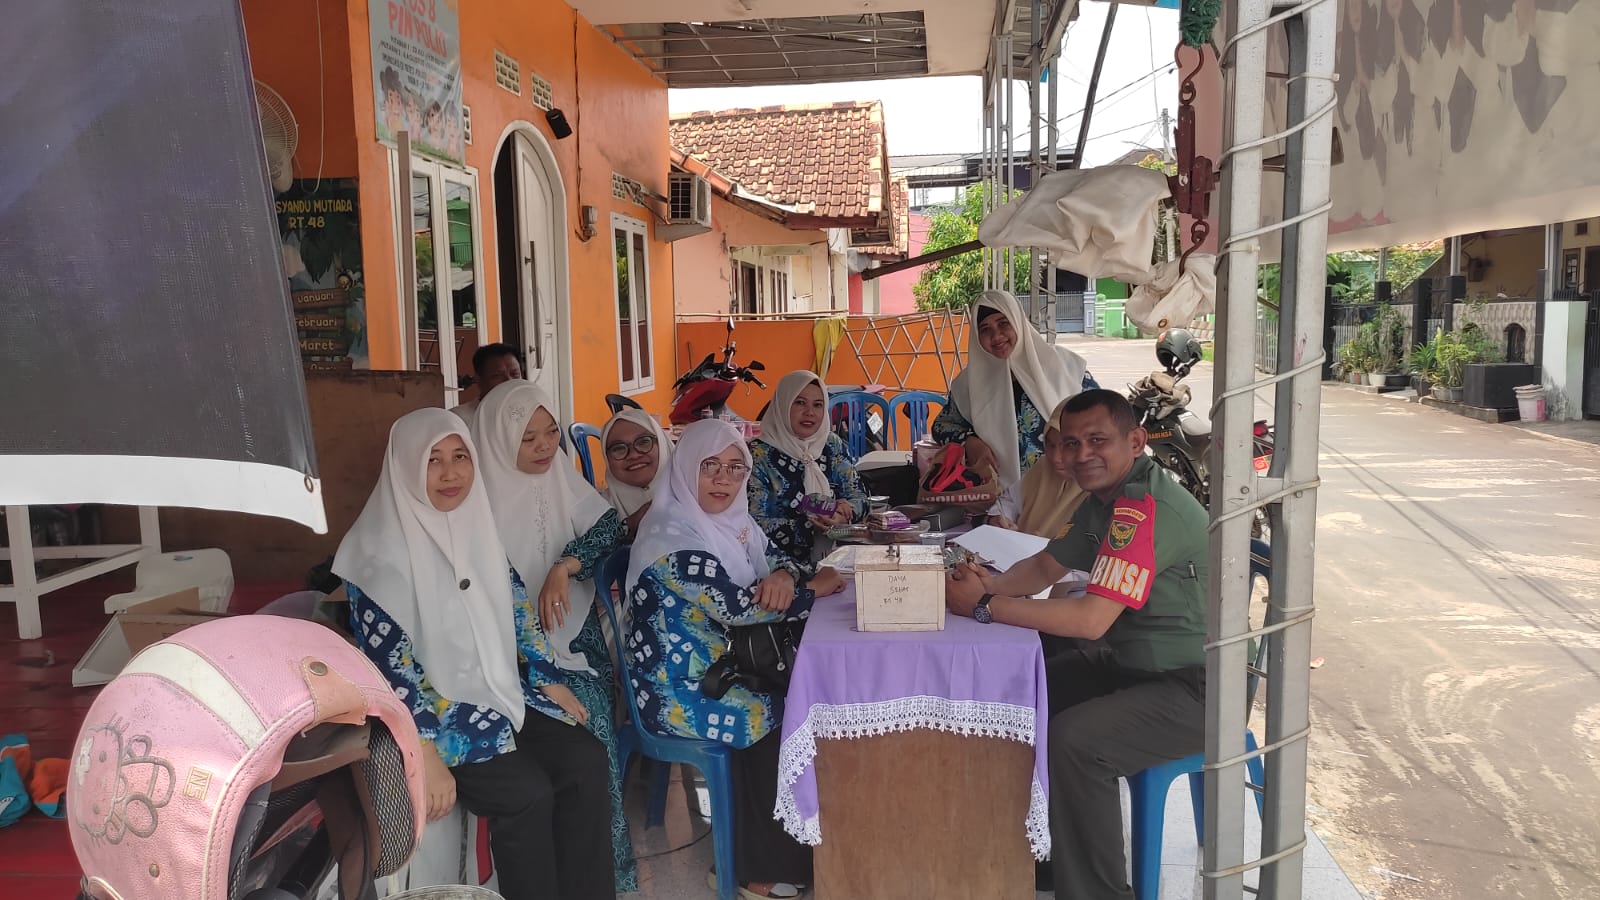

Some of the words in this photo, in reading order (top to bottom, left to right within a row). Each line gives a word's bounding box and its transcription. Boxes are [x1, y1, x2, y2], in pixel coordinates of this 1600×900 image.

[276, 200, 311, 213] SYANDU
[313, 199, 353, 213] MUTIARA
[1090, 555, 1150, 601] BINSA
